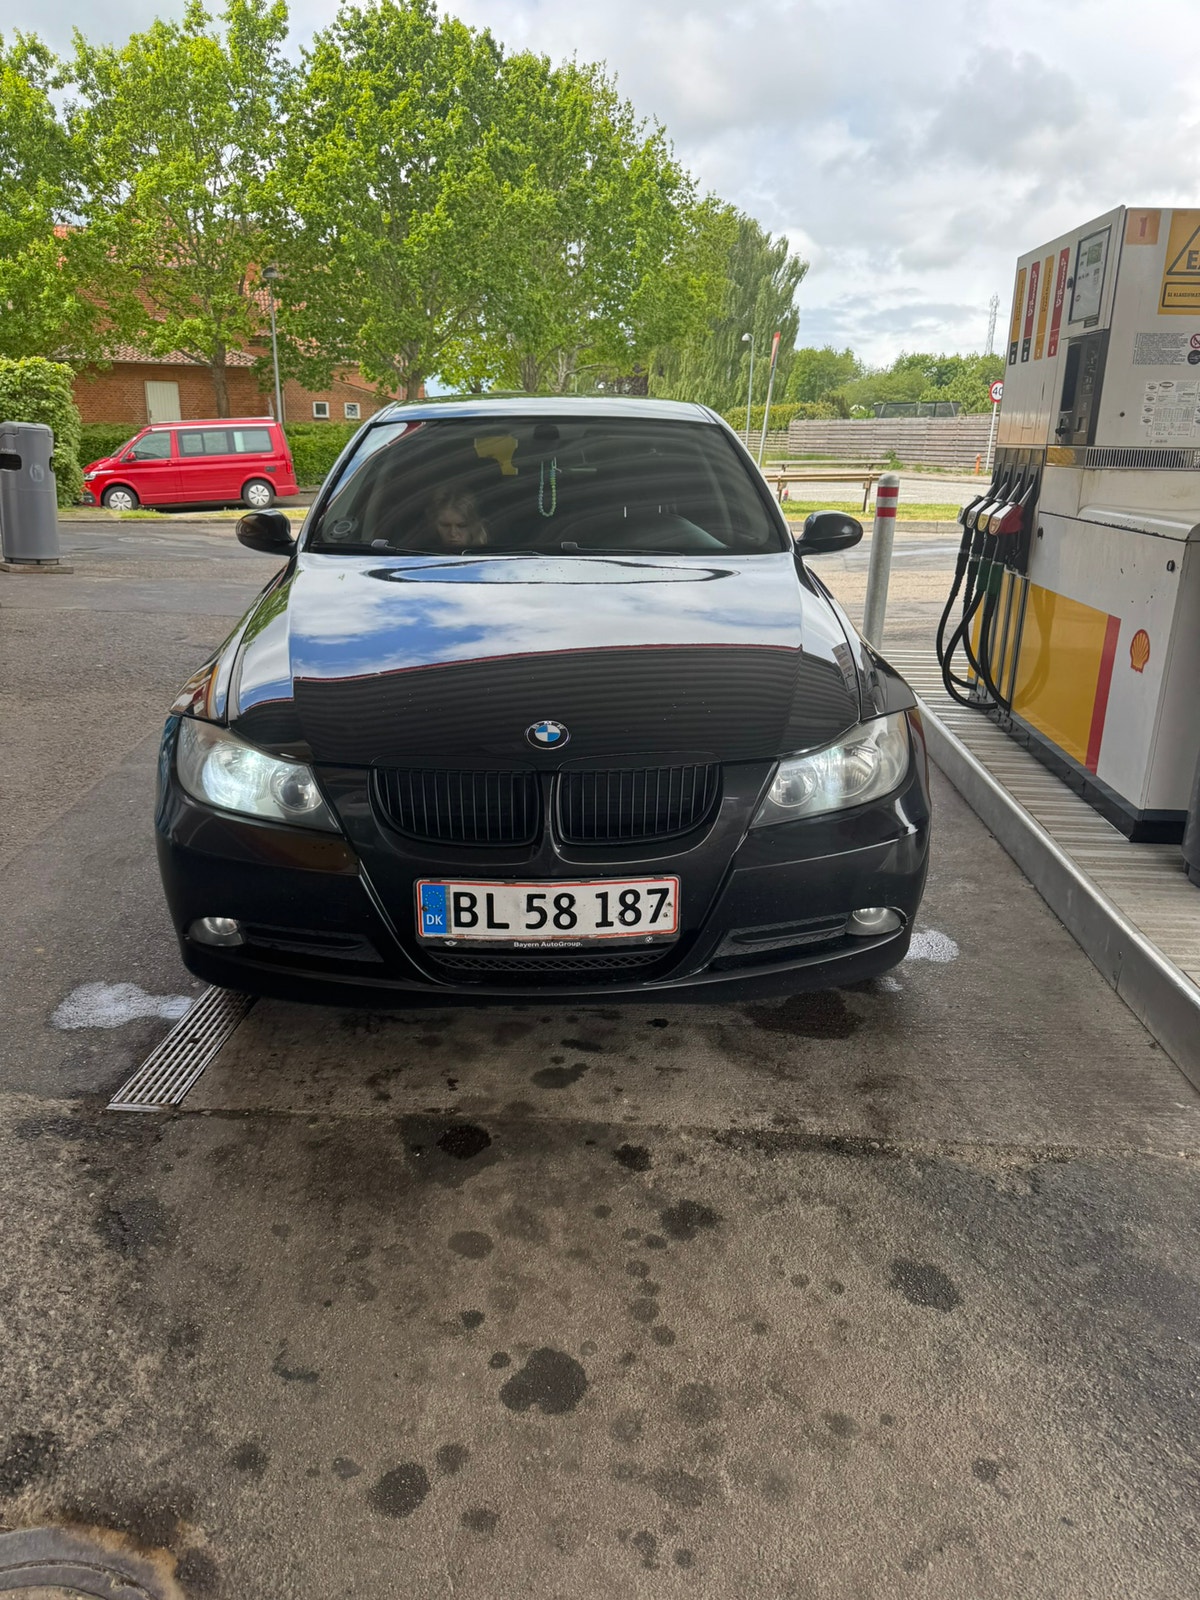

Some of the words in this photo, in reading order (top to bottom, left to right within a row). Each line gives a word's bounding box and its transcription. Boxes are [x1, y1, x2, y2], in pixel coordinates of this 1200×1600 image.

[1139, 217, 1148, 237] 1
[1186, 250, 1200, 270] E
[453, 892, 510, 929] BL
[525, 893, 578, 930] 58
[595, 888, 670, 928] 187
[426, 914, 443, 925] DK
[513, 941, 540, 949] Bayern
